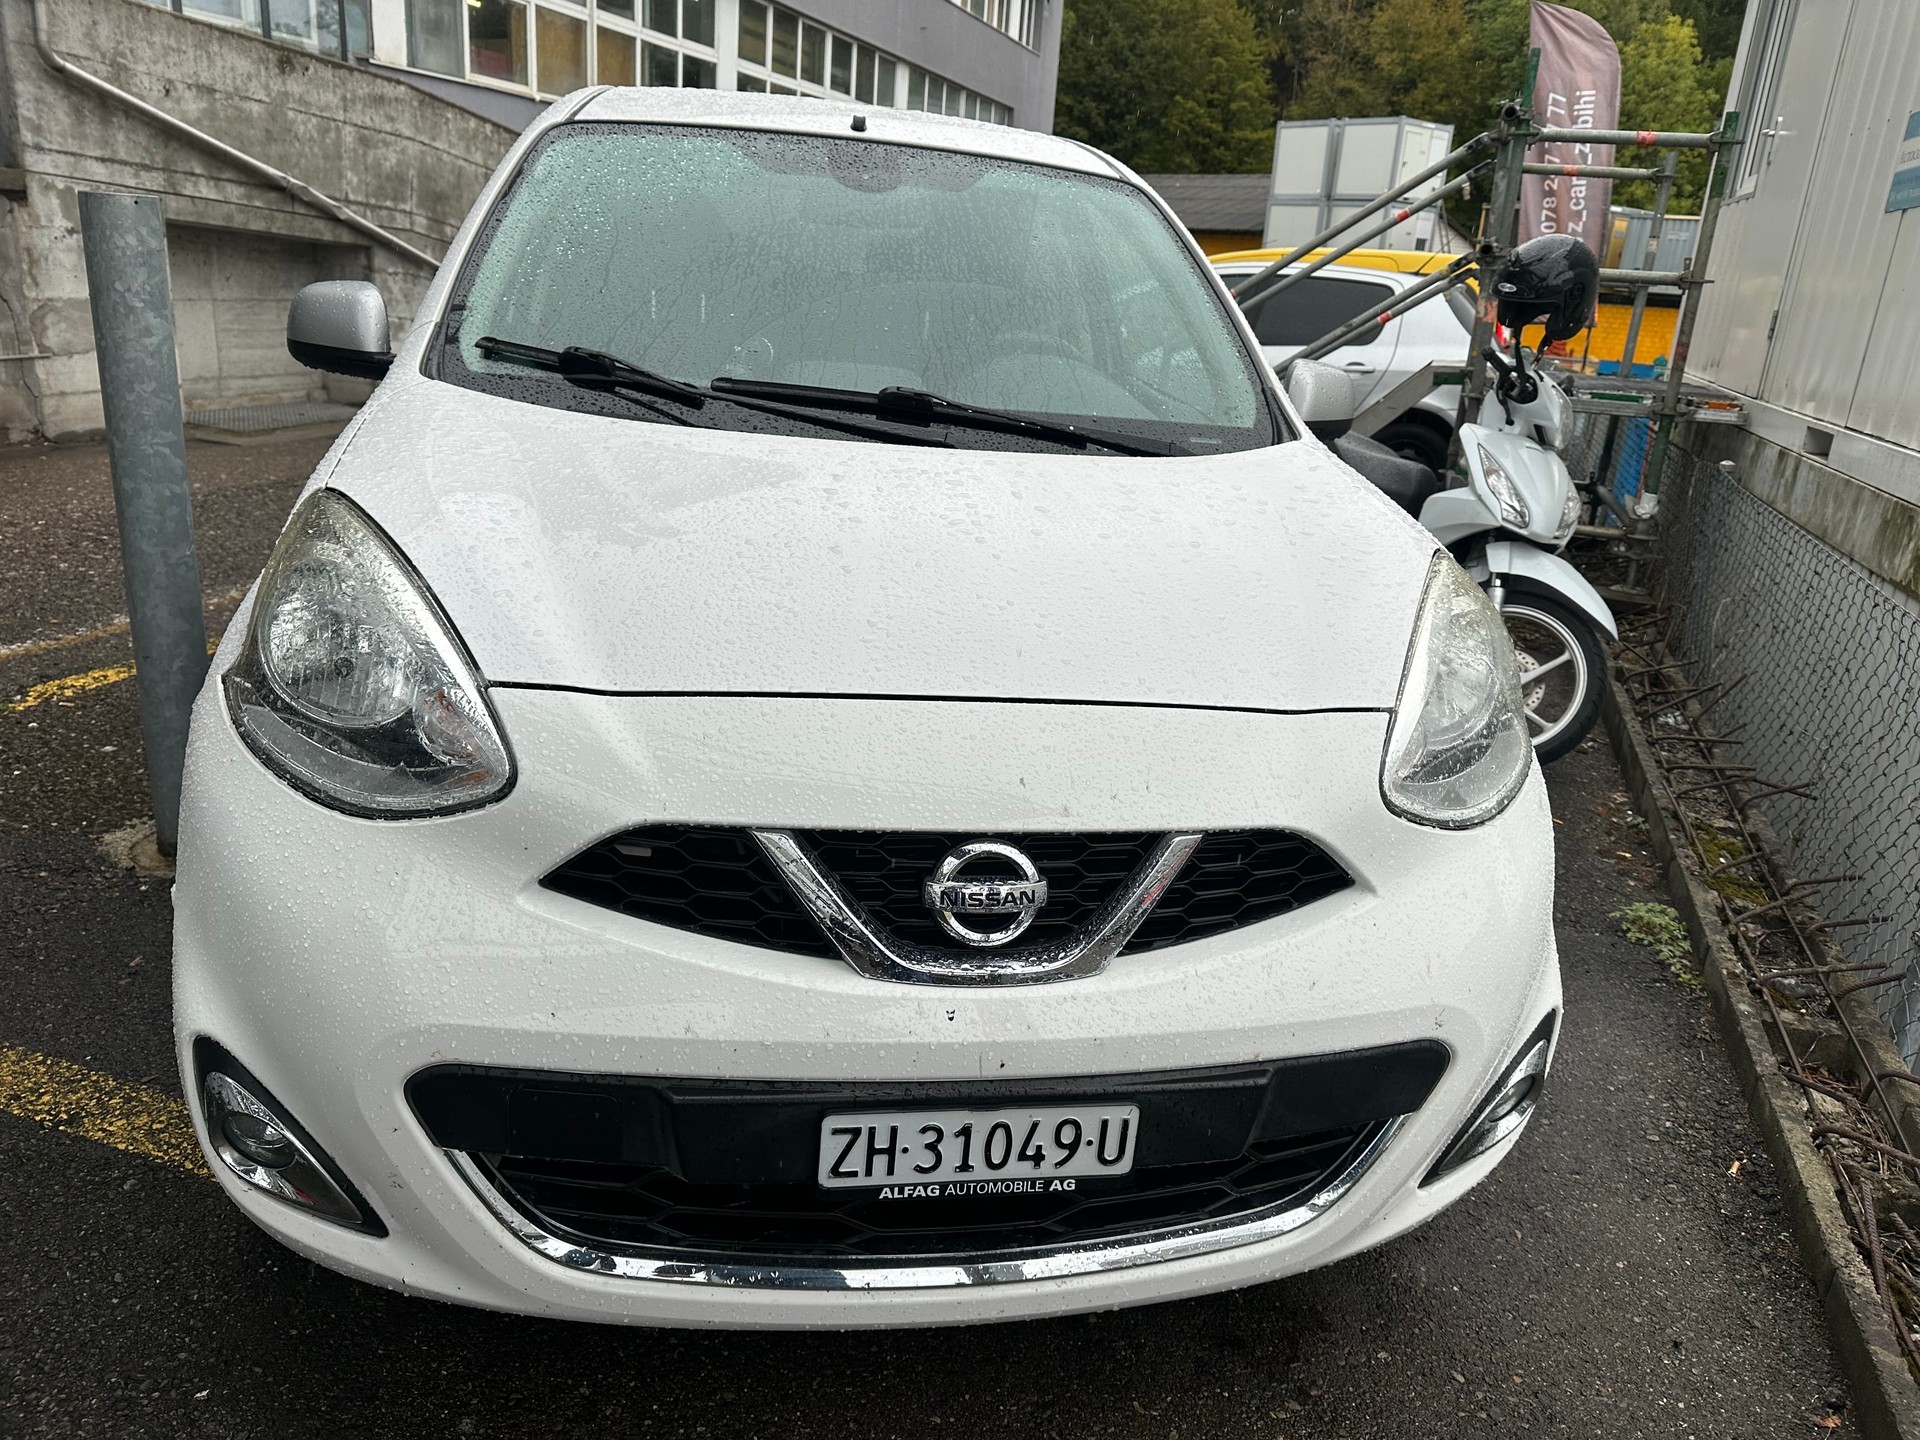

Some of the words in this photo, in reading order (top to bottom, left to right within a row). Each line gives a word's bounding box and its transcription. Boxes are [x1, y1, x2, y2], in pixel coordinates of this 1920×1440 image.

[1547, 92, 1567, 118] 77
[1544, 154, 1561, 192] 27
[1540, 196, 1557, 234] 078
[939, 889, 1036, 908] NISSAN
[878, 1184, 941, 1199] ALFAG
[944, 1180, 1044, 1197] AUTOMOBILE
[1049, 1179, 1076, 1193] AG
